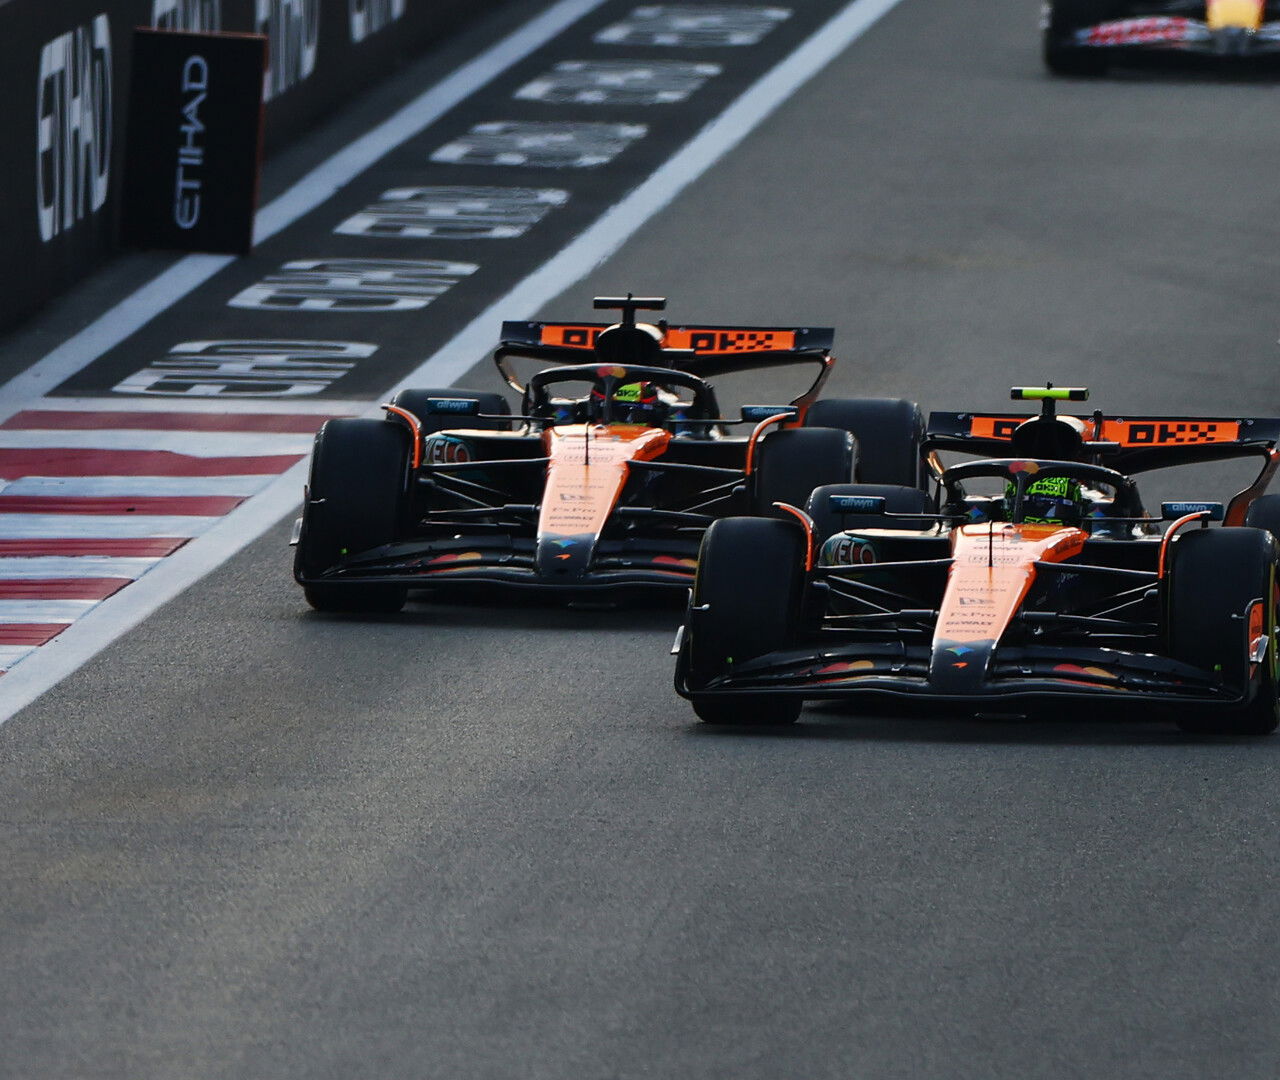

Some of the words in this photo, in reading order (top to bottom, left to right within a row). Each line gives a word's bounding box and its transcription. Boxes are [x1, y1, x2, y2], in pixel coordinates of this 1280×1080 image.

[173, 54, 210, 231] ETIHAD
[691, 331, 774, 351] OKX
[1127, 424, 1217, 443] OKX
[840, 498, 874, 509] allwyn
